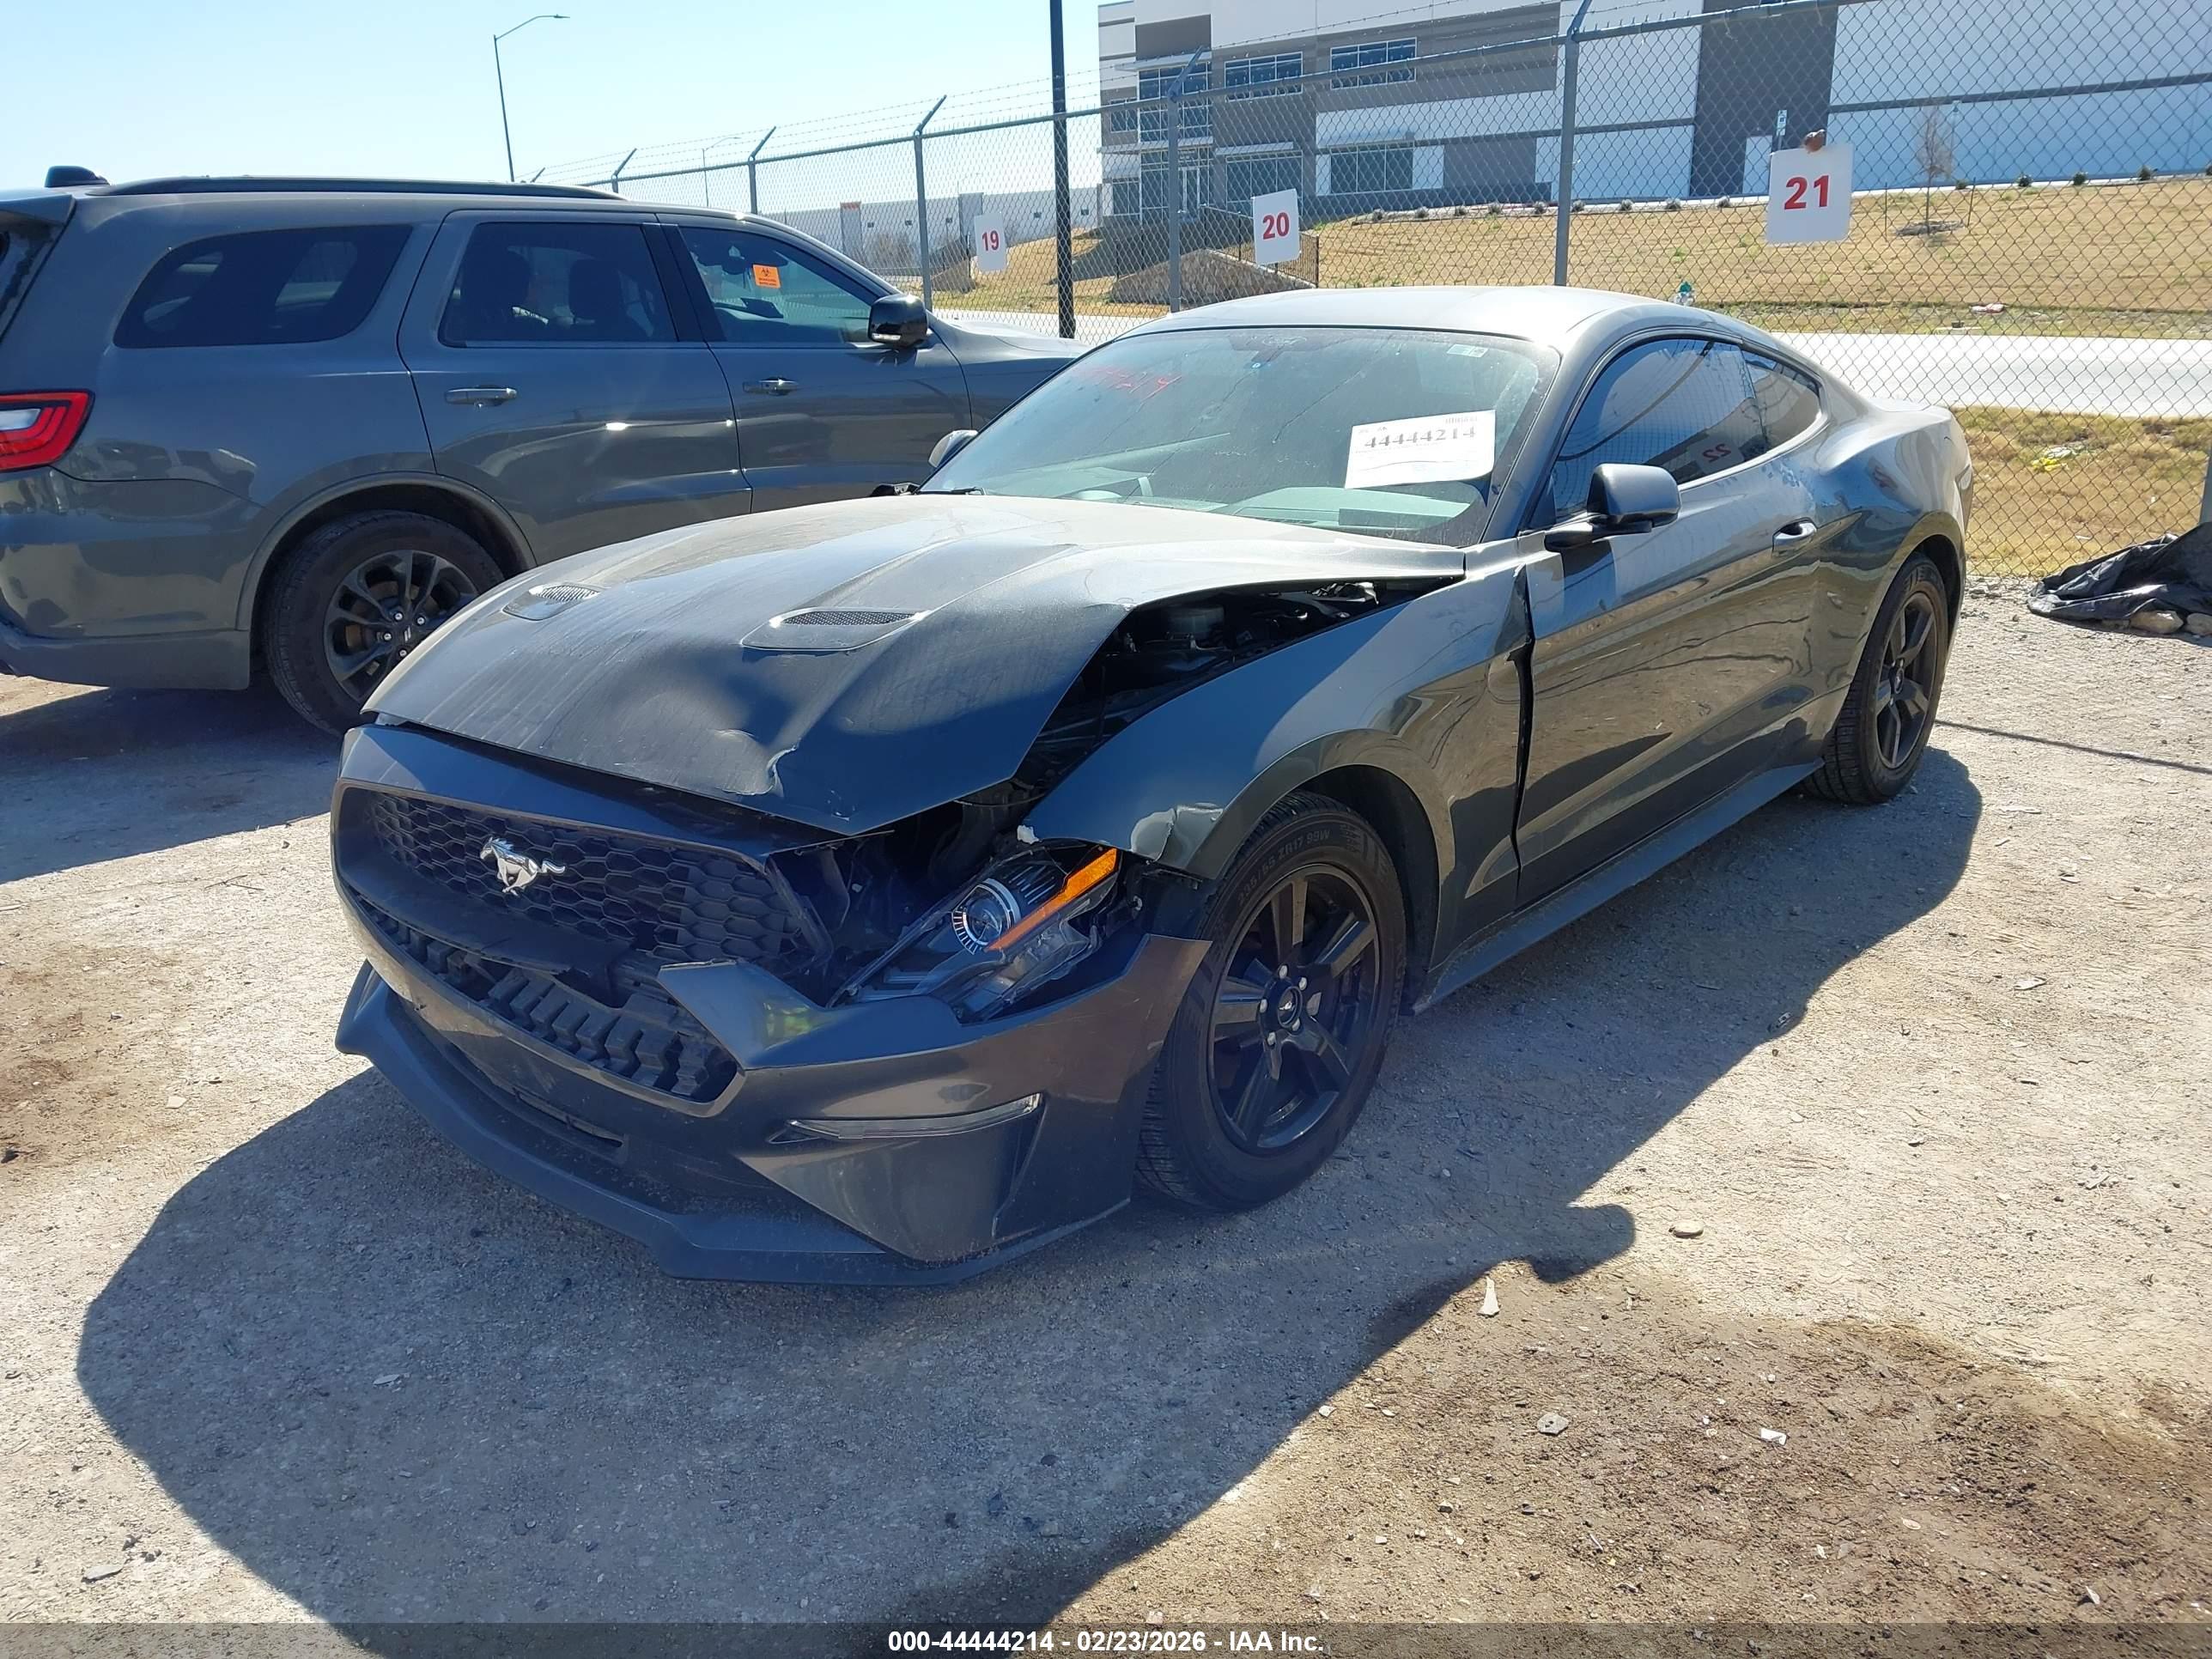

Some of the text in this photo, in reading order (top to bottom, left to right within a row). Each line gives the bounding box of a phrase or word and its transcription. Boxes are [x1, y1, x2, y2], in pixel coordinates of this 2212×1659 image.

[1784, 174, 1829, 210] 21
[1262, 212, 1290, 240] 20
[981, 230, 1000, 252] 19
[1364, 426, 1476, 447] 44444214
